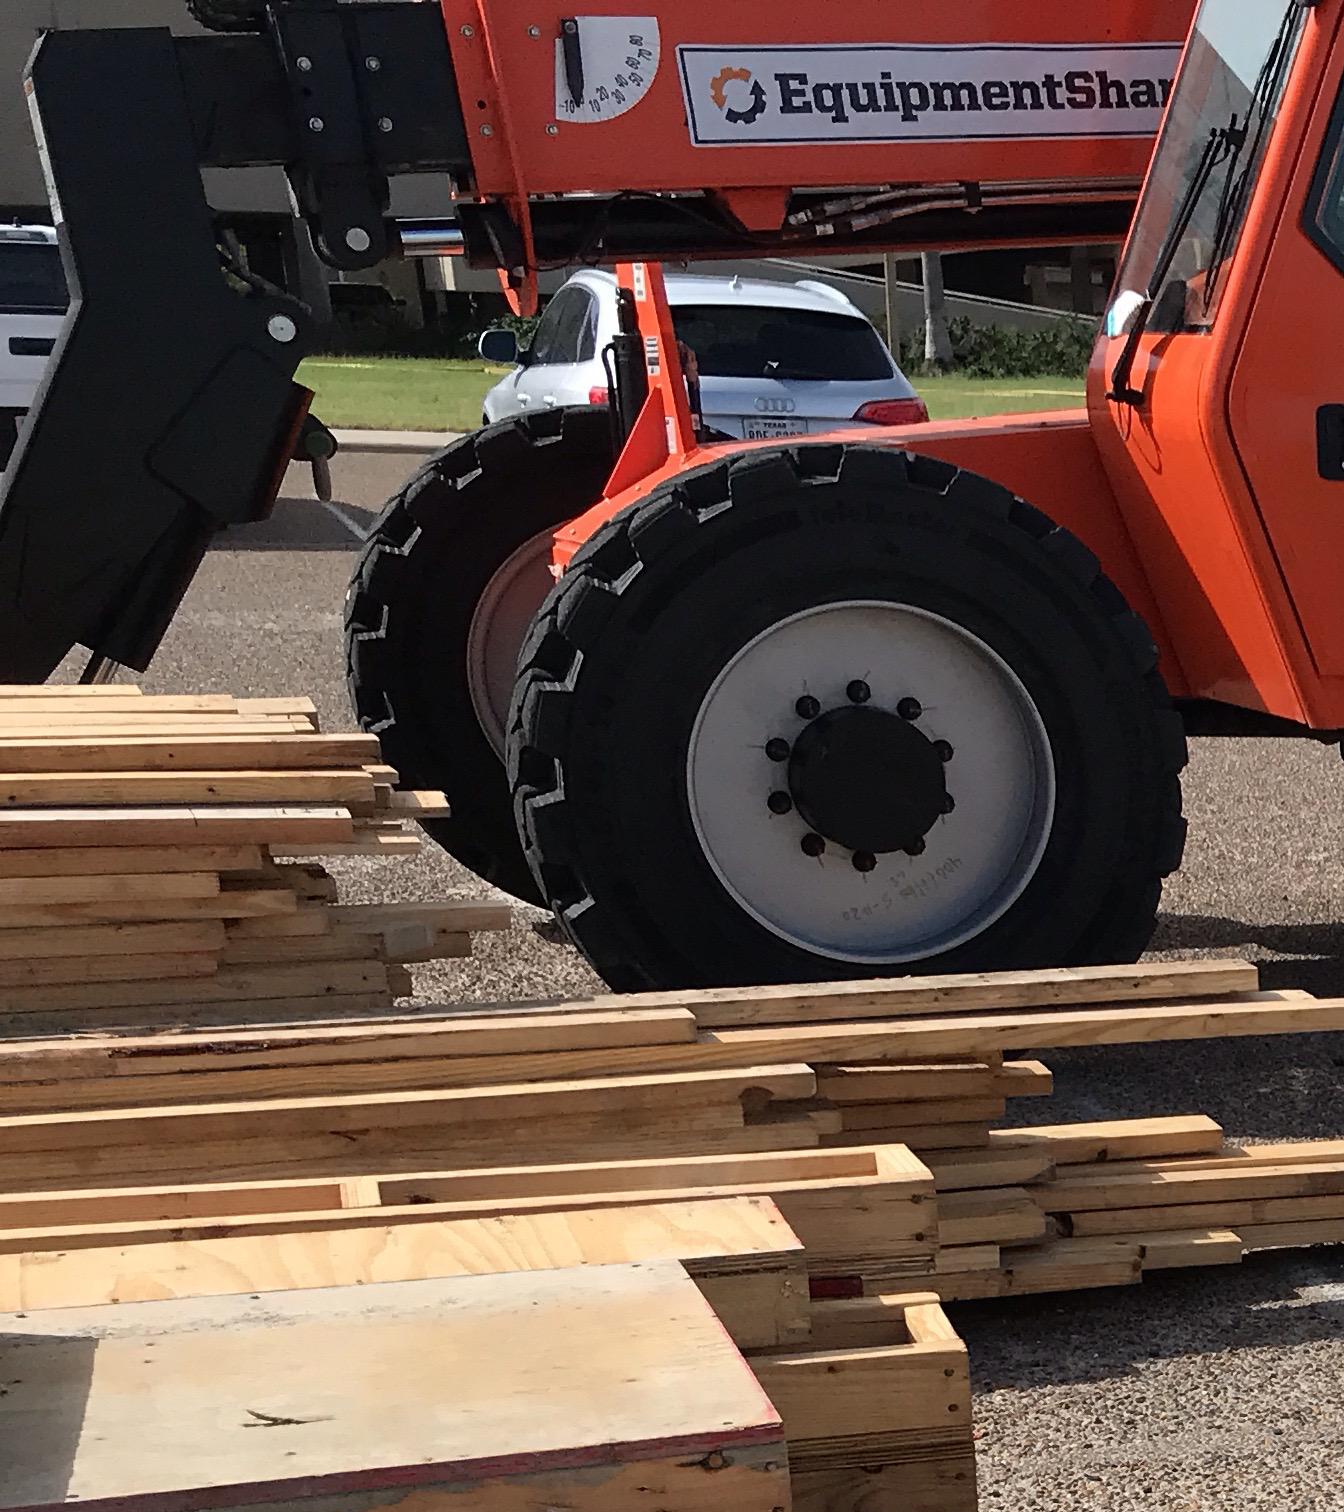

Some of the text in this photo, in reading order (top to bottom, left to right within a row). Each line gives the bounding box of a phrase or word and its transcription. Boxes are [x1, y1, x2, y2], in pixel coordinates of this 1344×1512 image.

[596, 85, 610, 102] 20
[774, 70, 1174, 123] EquipmentShar
[588, 99, 601, 112] 10
